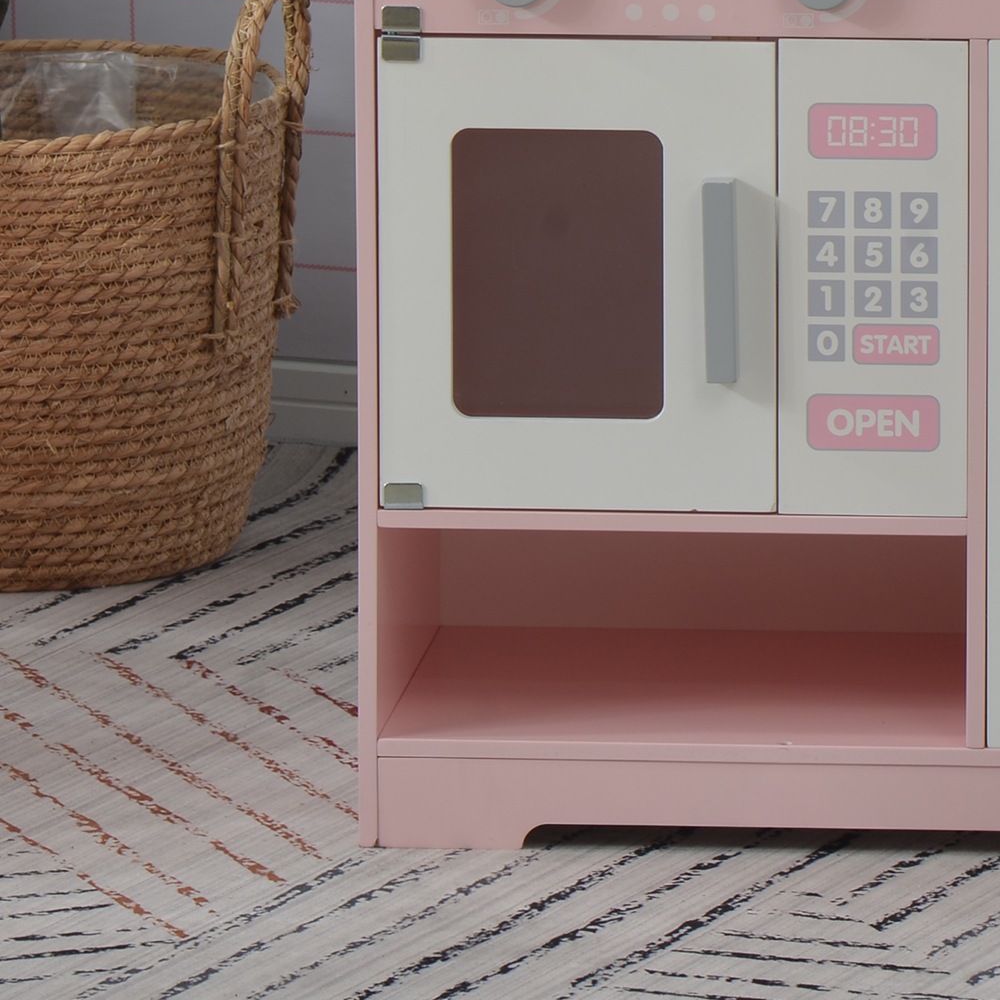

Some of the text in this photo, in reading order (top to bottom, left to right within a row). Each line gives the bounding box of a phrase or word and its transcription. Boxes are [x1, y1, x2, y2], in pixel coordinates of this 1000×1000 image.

[827, 116, 918, 147] 08:30
[818, 197, 929, 224] 7 8 9
[816, 241, 929, 268] 4 5 6
[820, 286, 928, 312] 1 2 3
[816, 330, 931, 356] 0 START
[827, 409, 920, 437] OPEN
